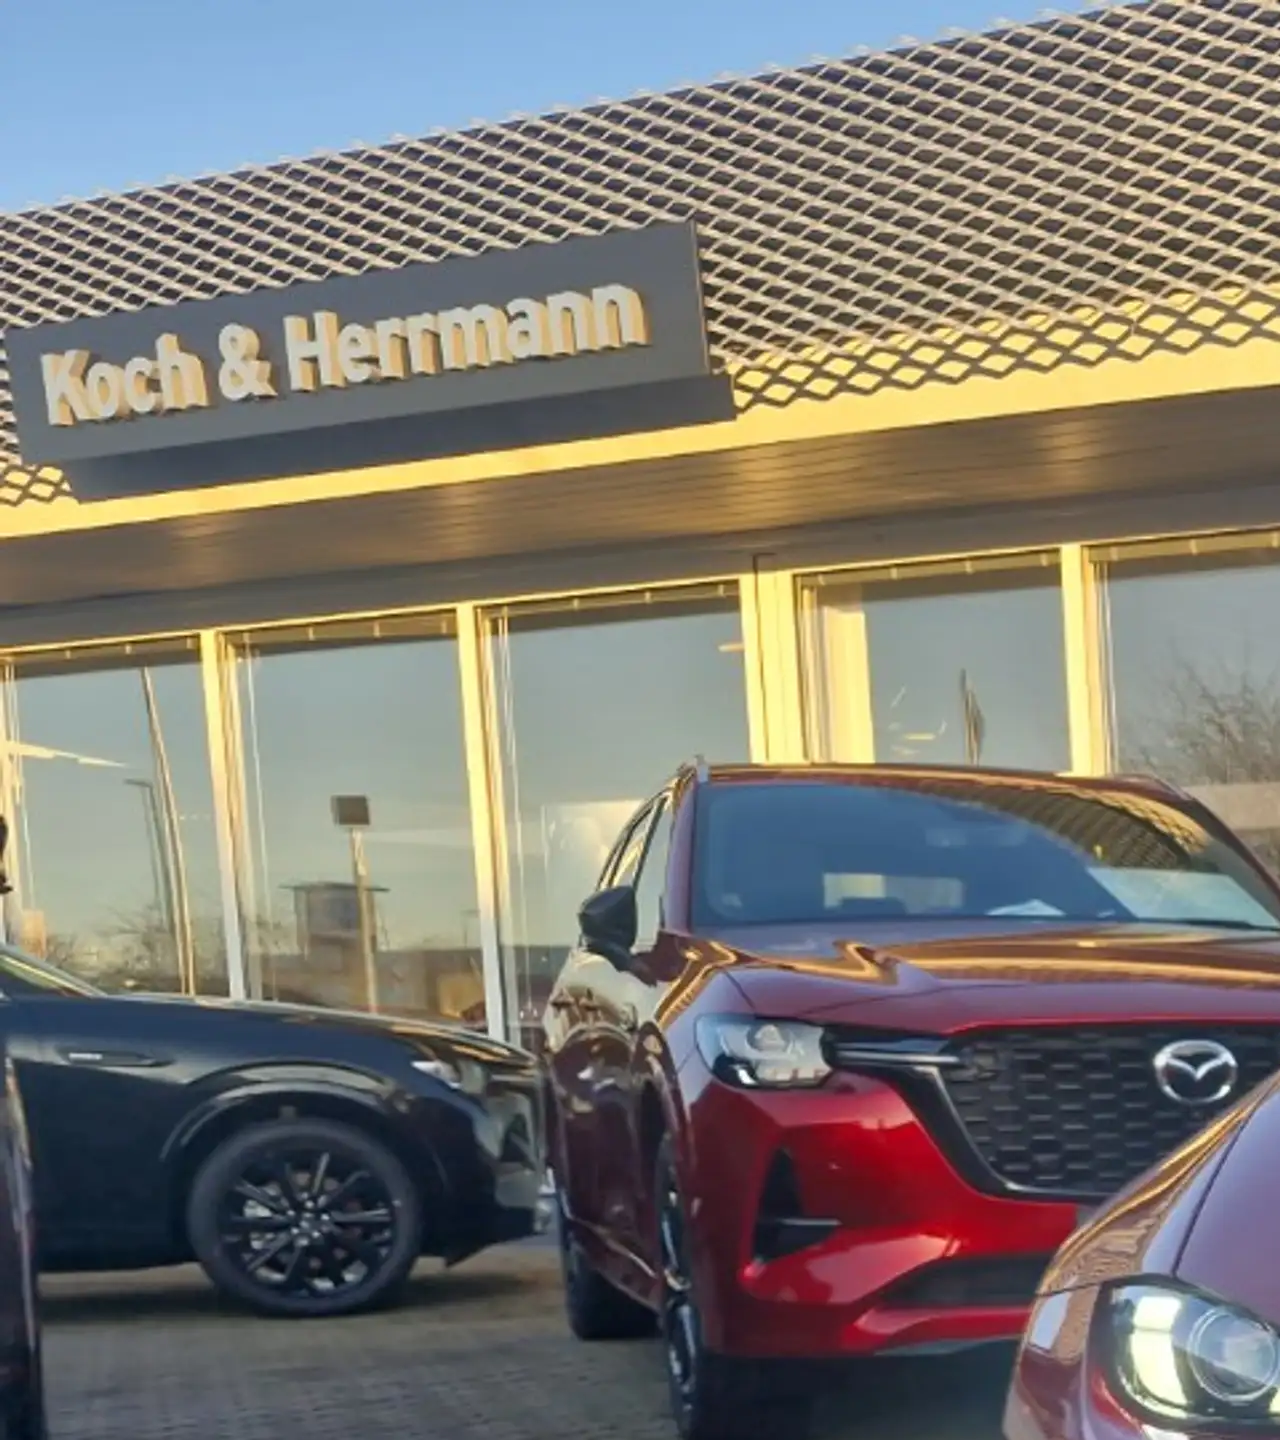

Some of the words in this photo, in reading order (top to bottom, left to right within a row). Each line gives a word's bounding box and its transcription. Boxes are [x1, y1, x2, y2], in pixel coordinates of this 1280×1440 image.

[40, 332, 206, 425] Koch
[217, 322, 277, 400] &
[284, 284, 650, 391] Herrmann
